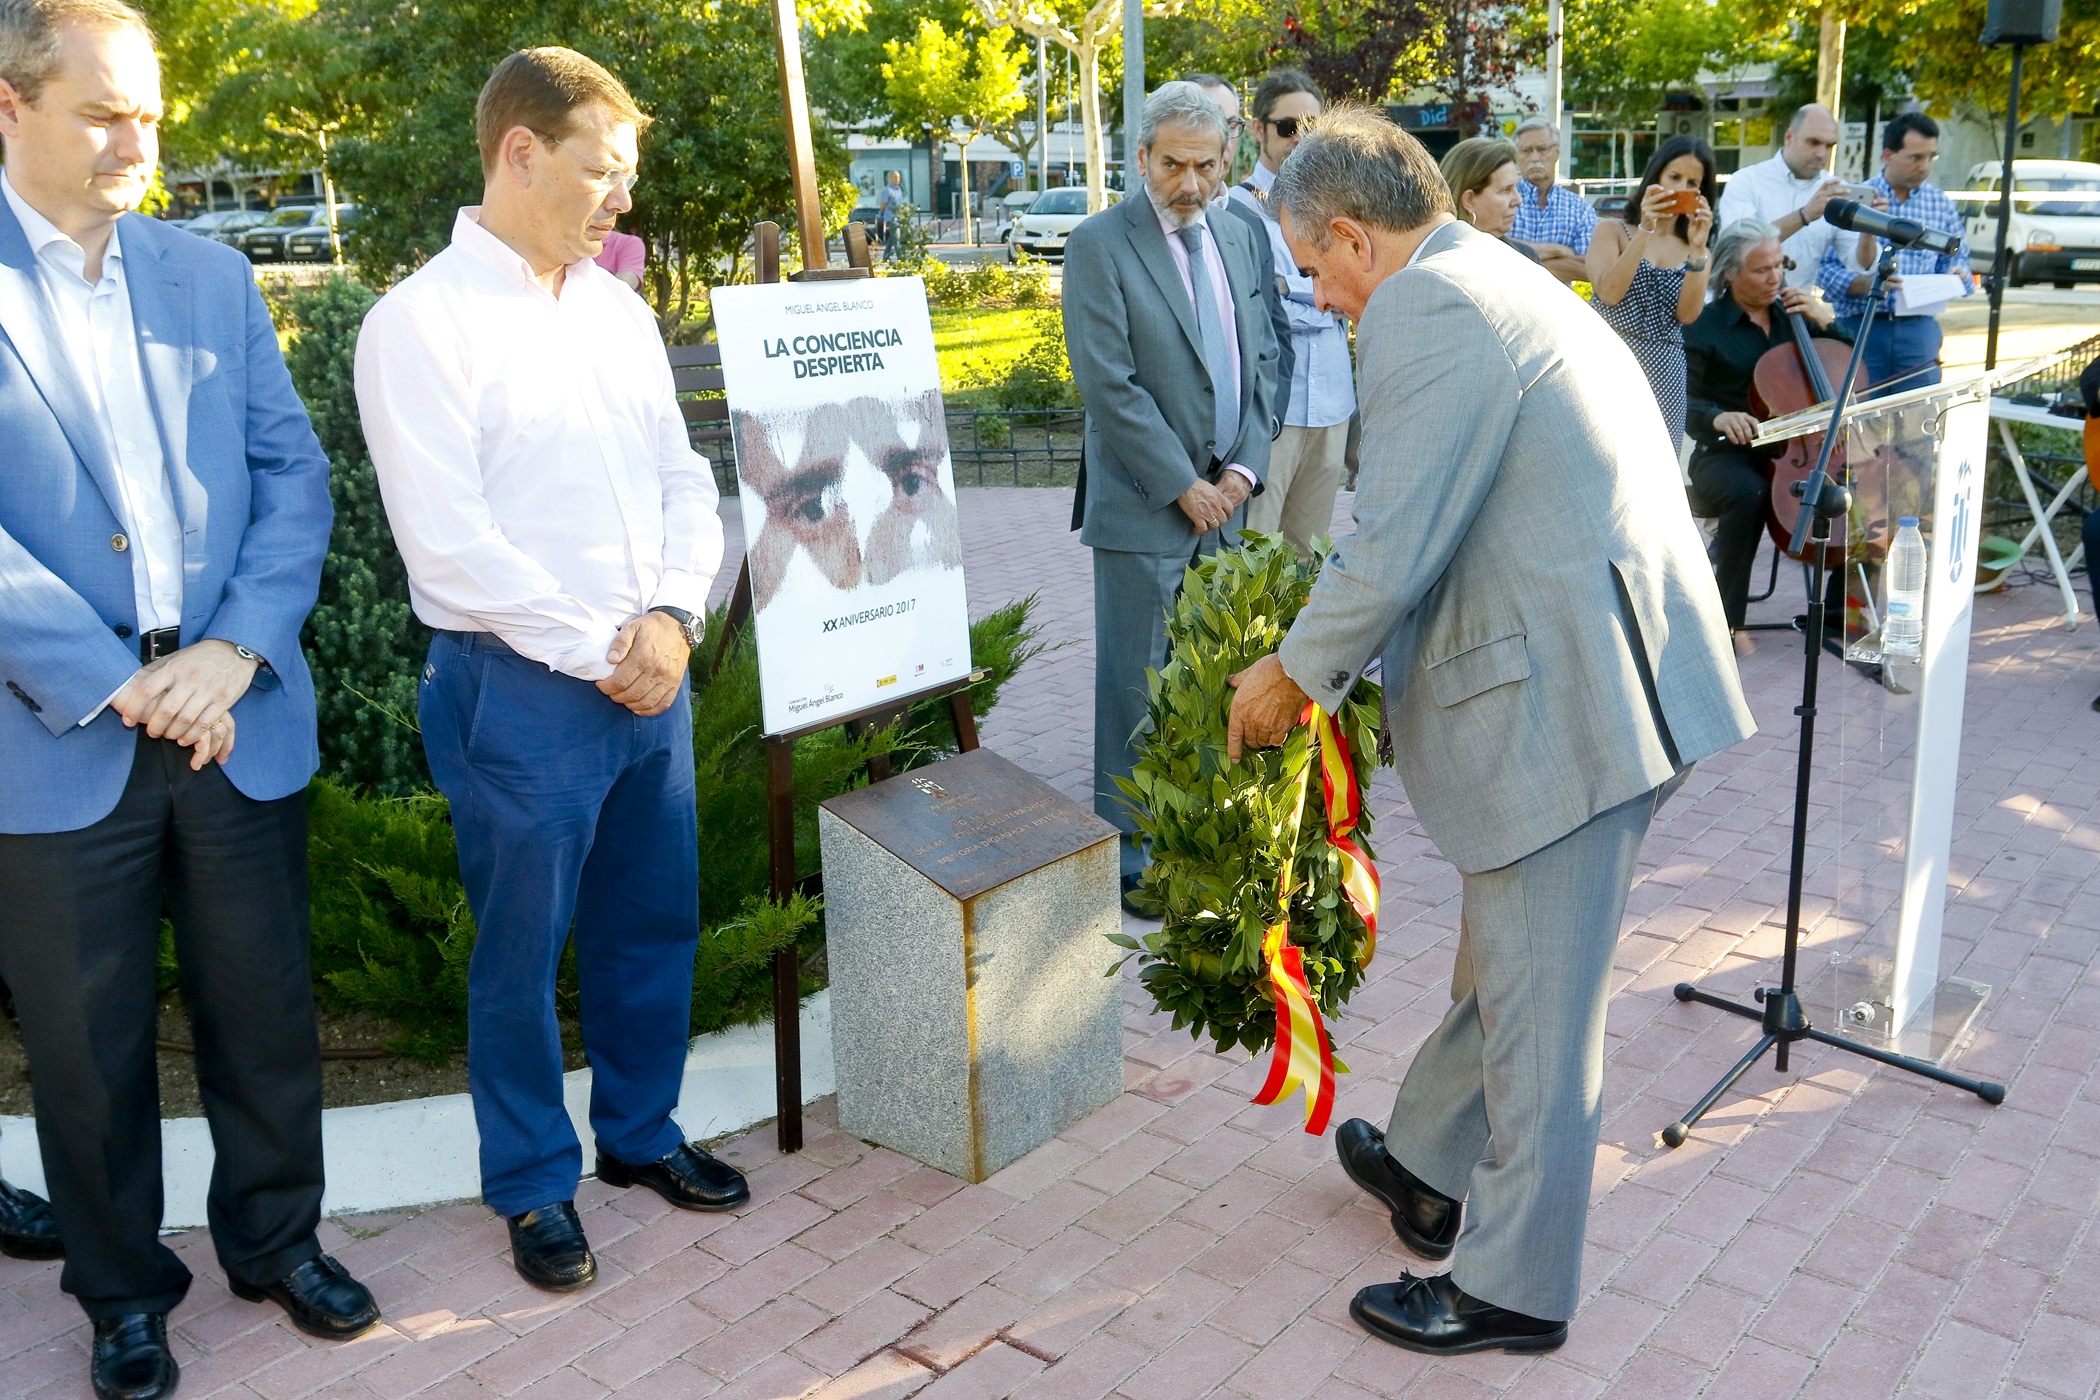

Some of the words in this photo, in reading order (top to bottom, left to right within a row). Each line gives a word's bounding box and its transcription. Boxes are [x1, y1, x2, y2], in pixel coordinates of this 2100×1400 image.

[785, 303, 815, 315] MIGUEL
[816, 301, 842, 313] ÁNGEL
[843, 300, 874, 311] BLANCO
[763, 338, 790, 358] LA
[792, 328, 903, 355] CONCIENCIA
[793, 352, 885, 379] DESPIERTA
[822, 618, 838, 633] XX
[838, 604, 894, 629] ANIVERSARIO
[896, 599, 916, 615] 2017
[788, 701, 808, 713] Miguel
[809, 696, 825, 708] Ángel
[825, 692, 844, 703] Blanco
